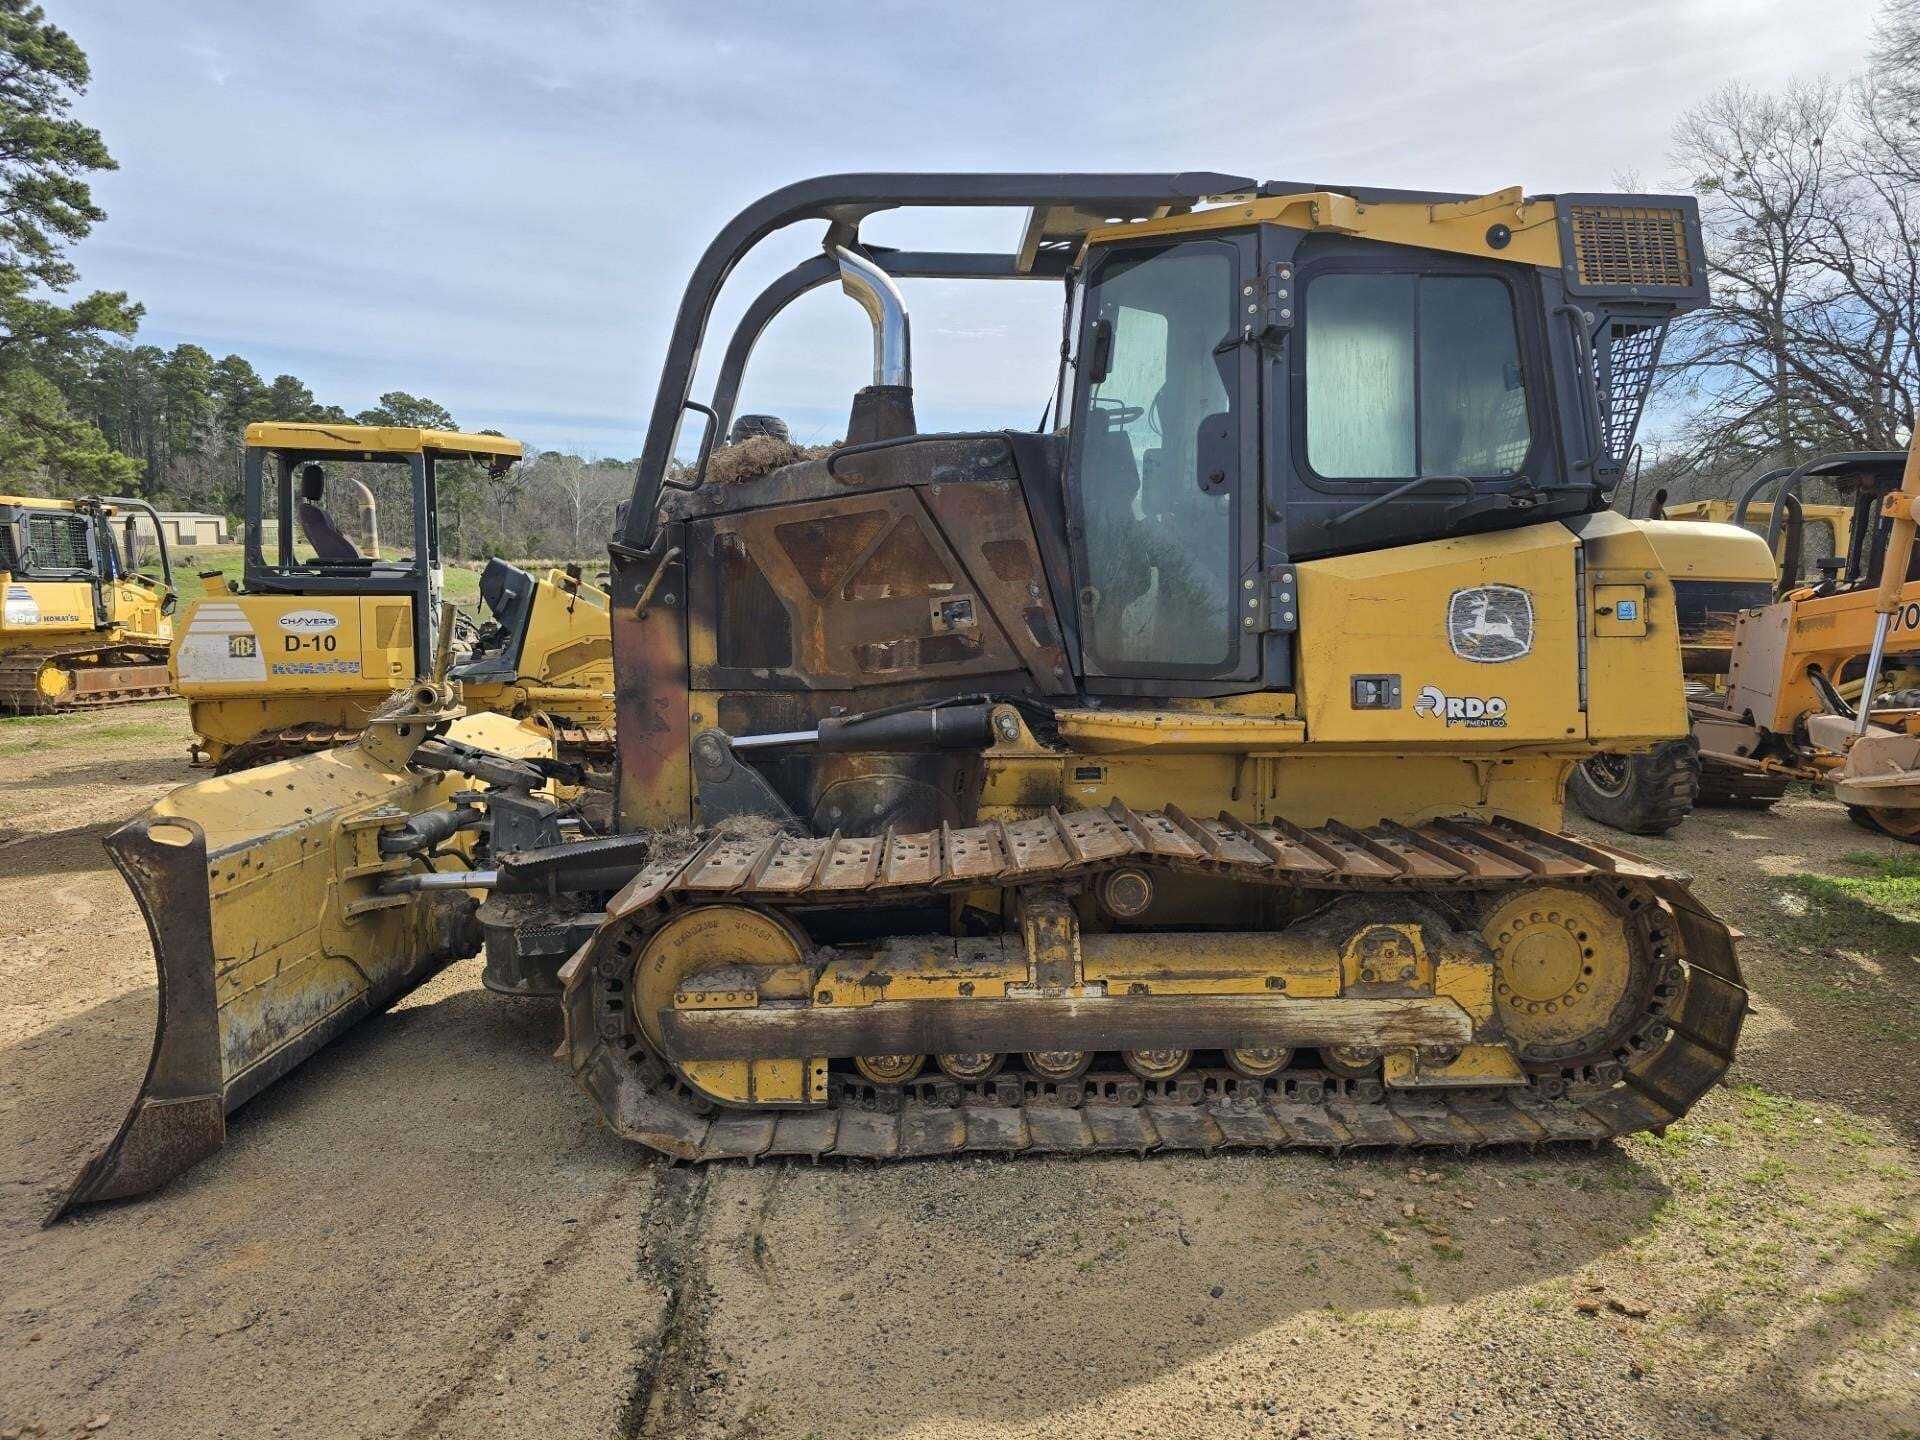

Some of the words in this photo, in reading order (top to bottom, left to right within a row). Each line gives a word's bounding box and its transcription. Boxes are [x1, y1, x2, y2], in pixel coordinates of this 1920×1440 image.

[43, 614, 80, 622] KOMATSU
[280, 616, 337, 627] CHAVERS
[285, 635, 336, 652] D-10
[272, 660, 359, 675] KOMATSU
[1446, 697, 1507, 718] RDO
[1447, 719, 1491, 728] EQUIPMENT
